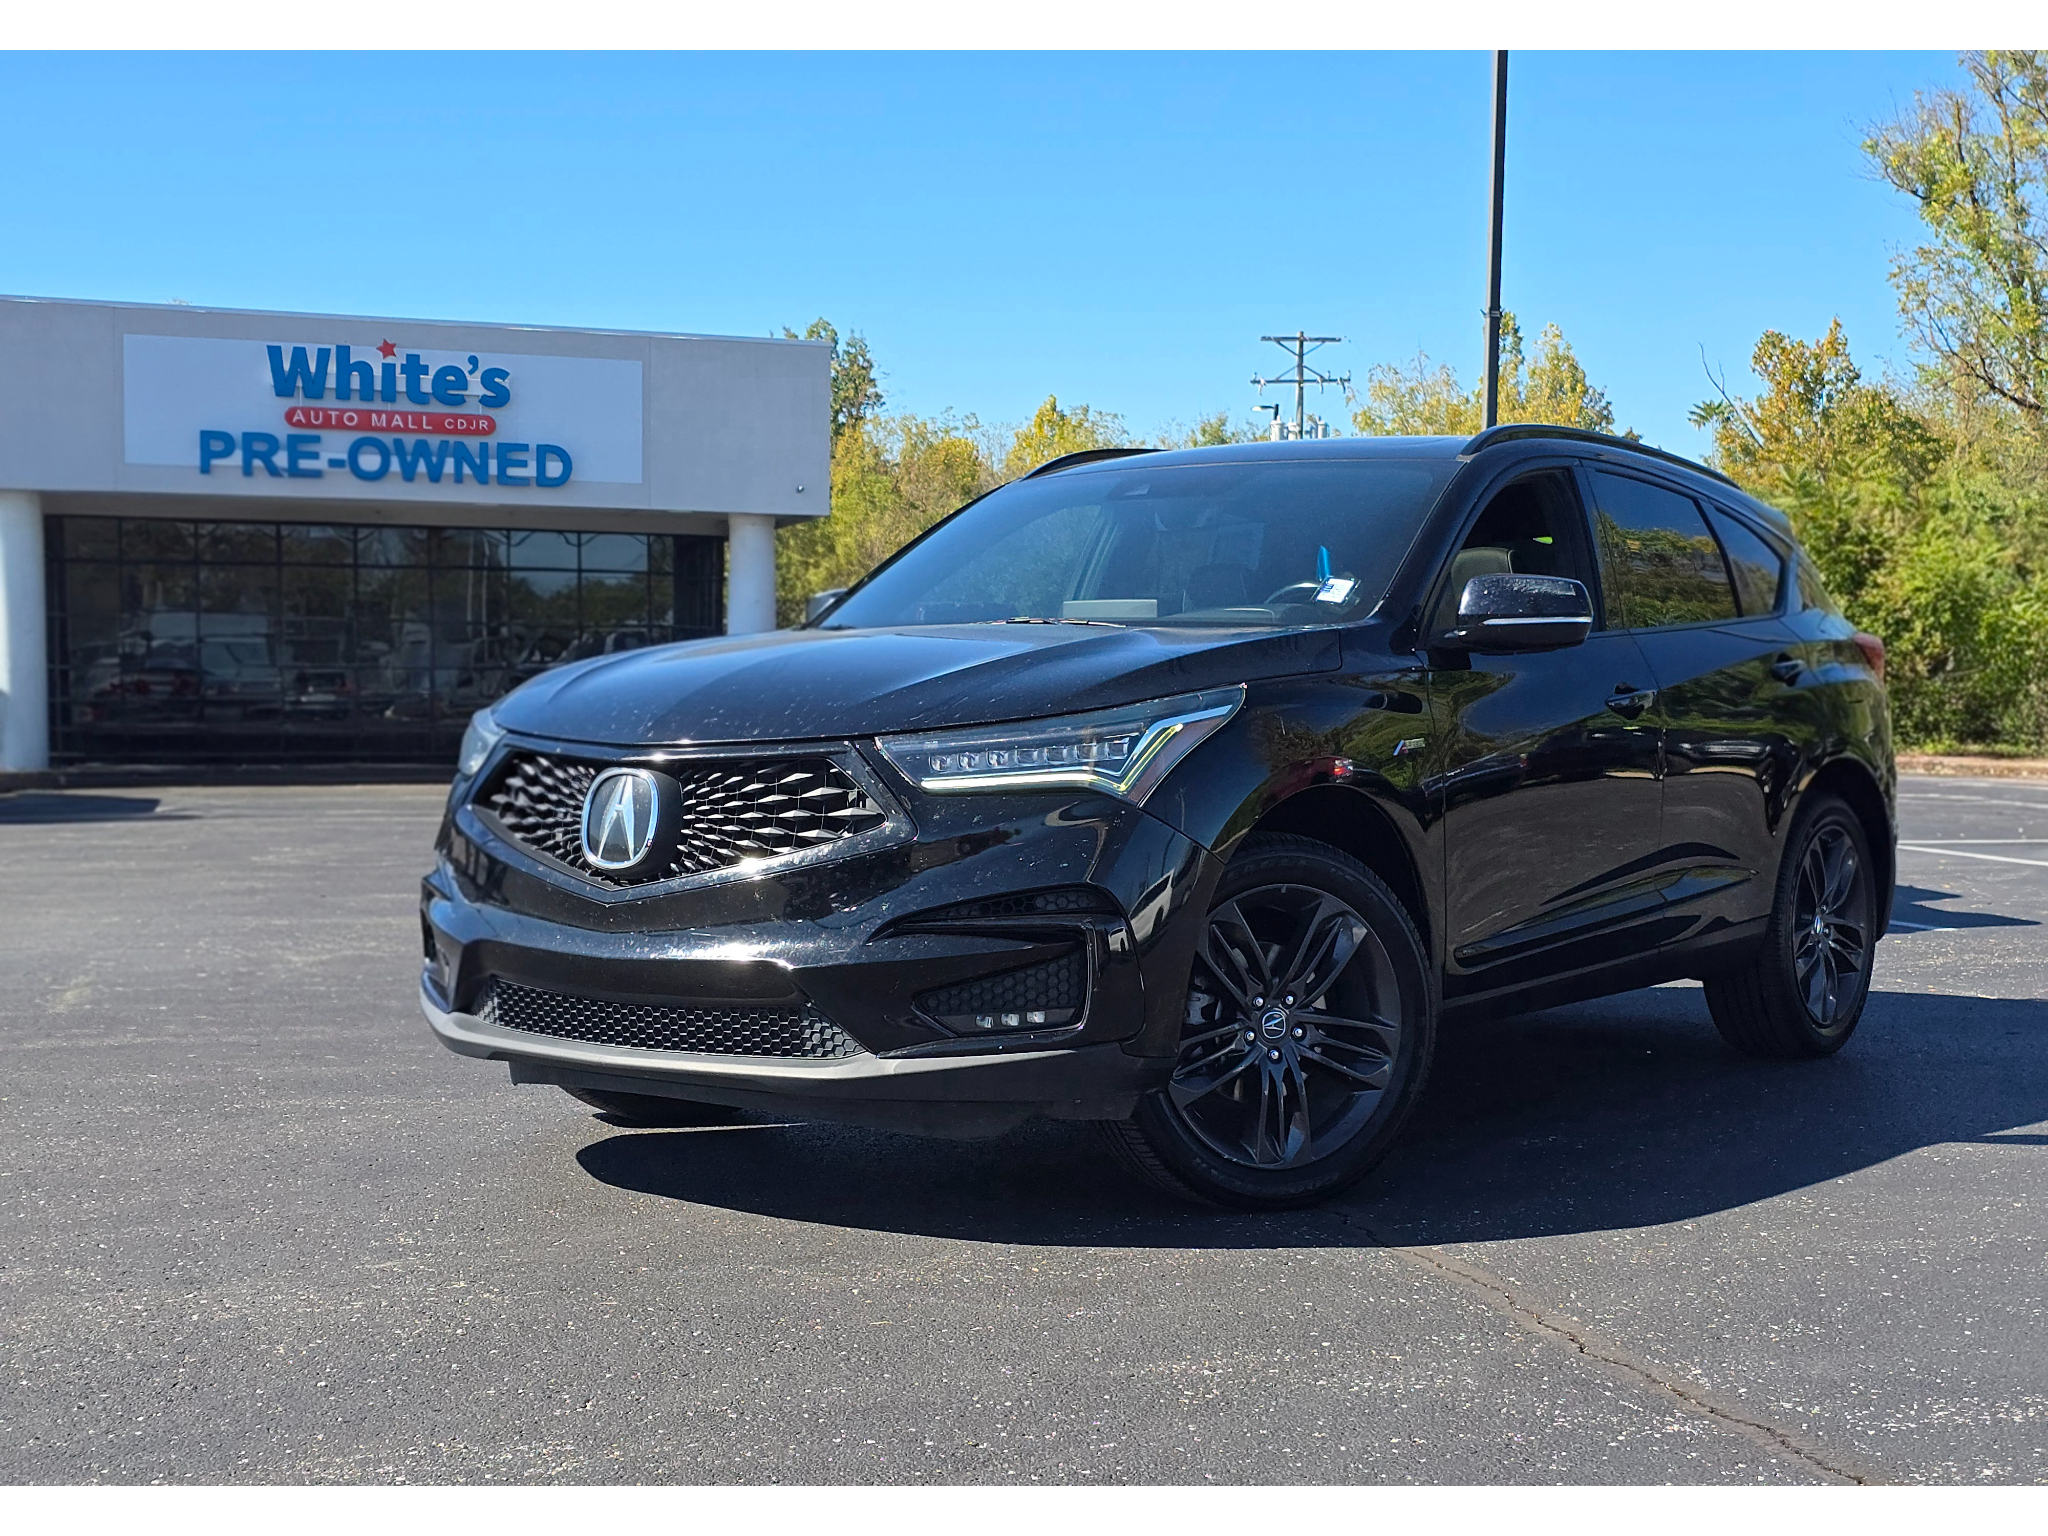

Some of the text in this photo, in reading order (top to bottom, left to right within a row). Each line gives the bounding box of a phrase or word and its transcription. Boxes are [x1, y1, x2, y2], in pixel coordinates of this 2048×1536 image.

[266, 340, 511, 409] White's
[291, 409, 490, 431] AUTO MALL CDJR
[199, 429, 573, 488] PRE-OWNED
